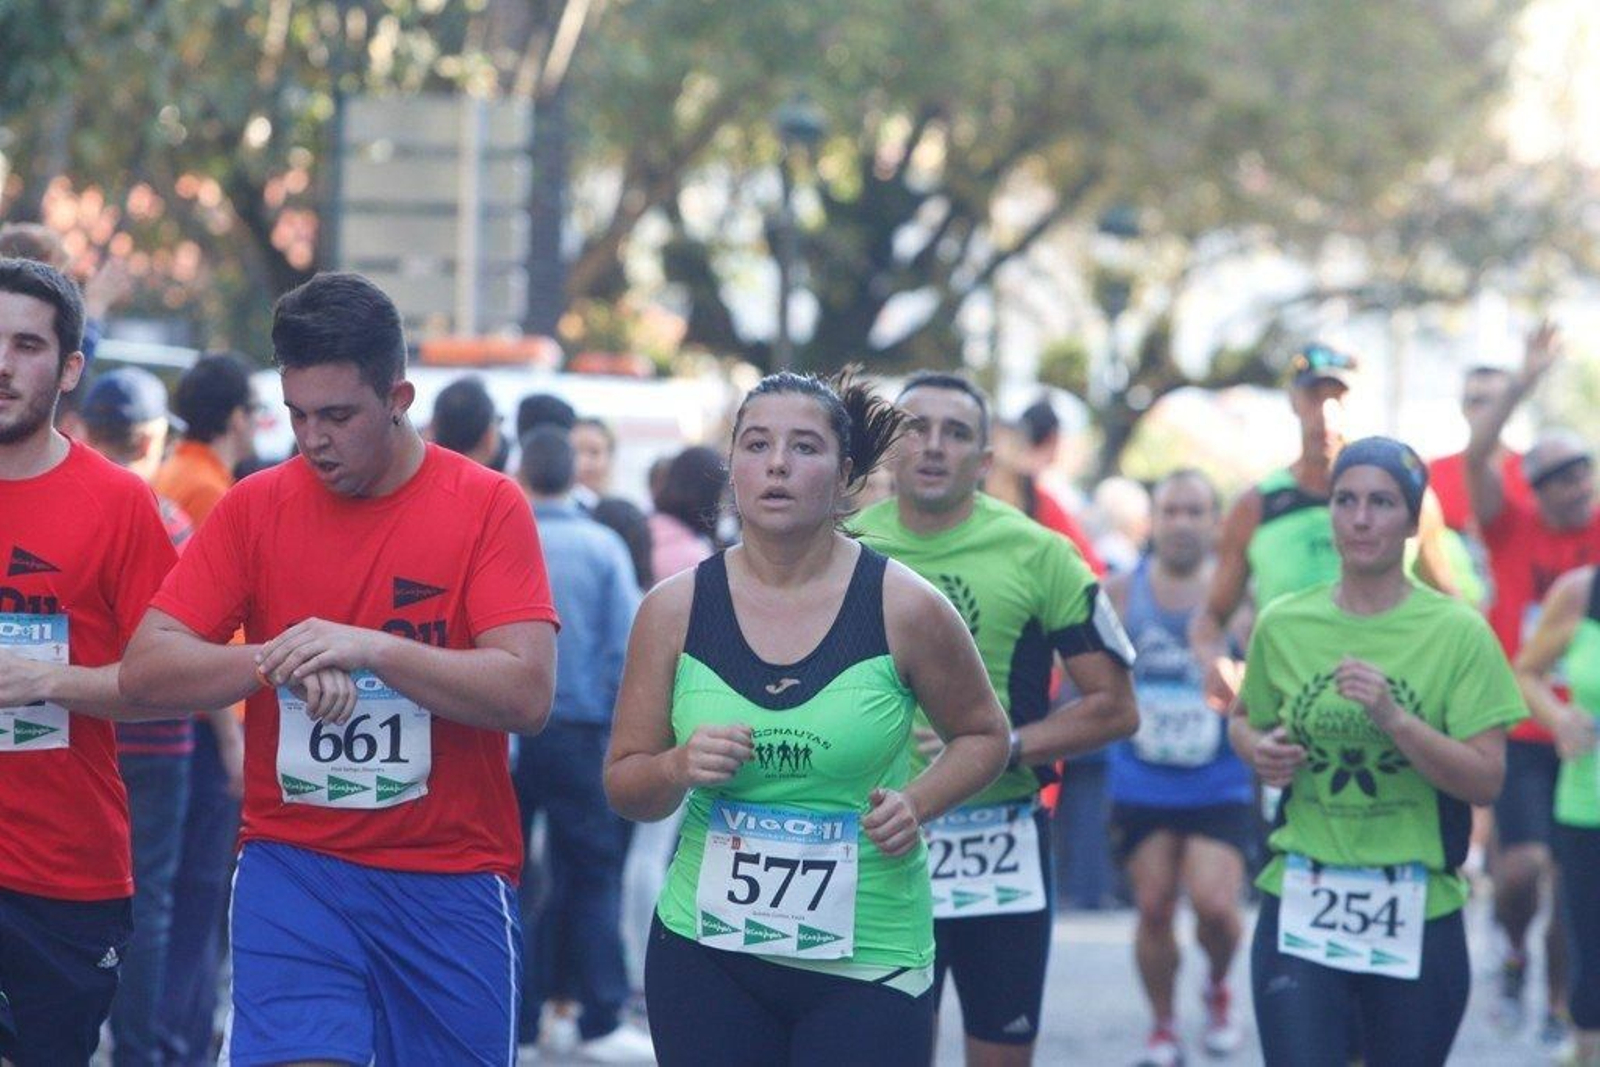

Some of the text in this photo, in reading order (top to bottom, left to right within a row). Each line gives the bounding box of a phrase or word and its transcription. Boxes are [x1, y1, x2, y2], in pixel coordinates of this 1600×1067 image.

[309, 713, 409, 764] 661
[727, 852, 838, 911] 577
[927, 832, 1019, 881] 252
[1309, 887, 1405, 939] 254
